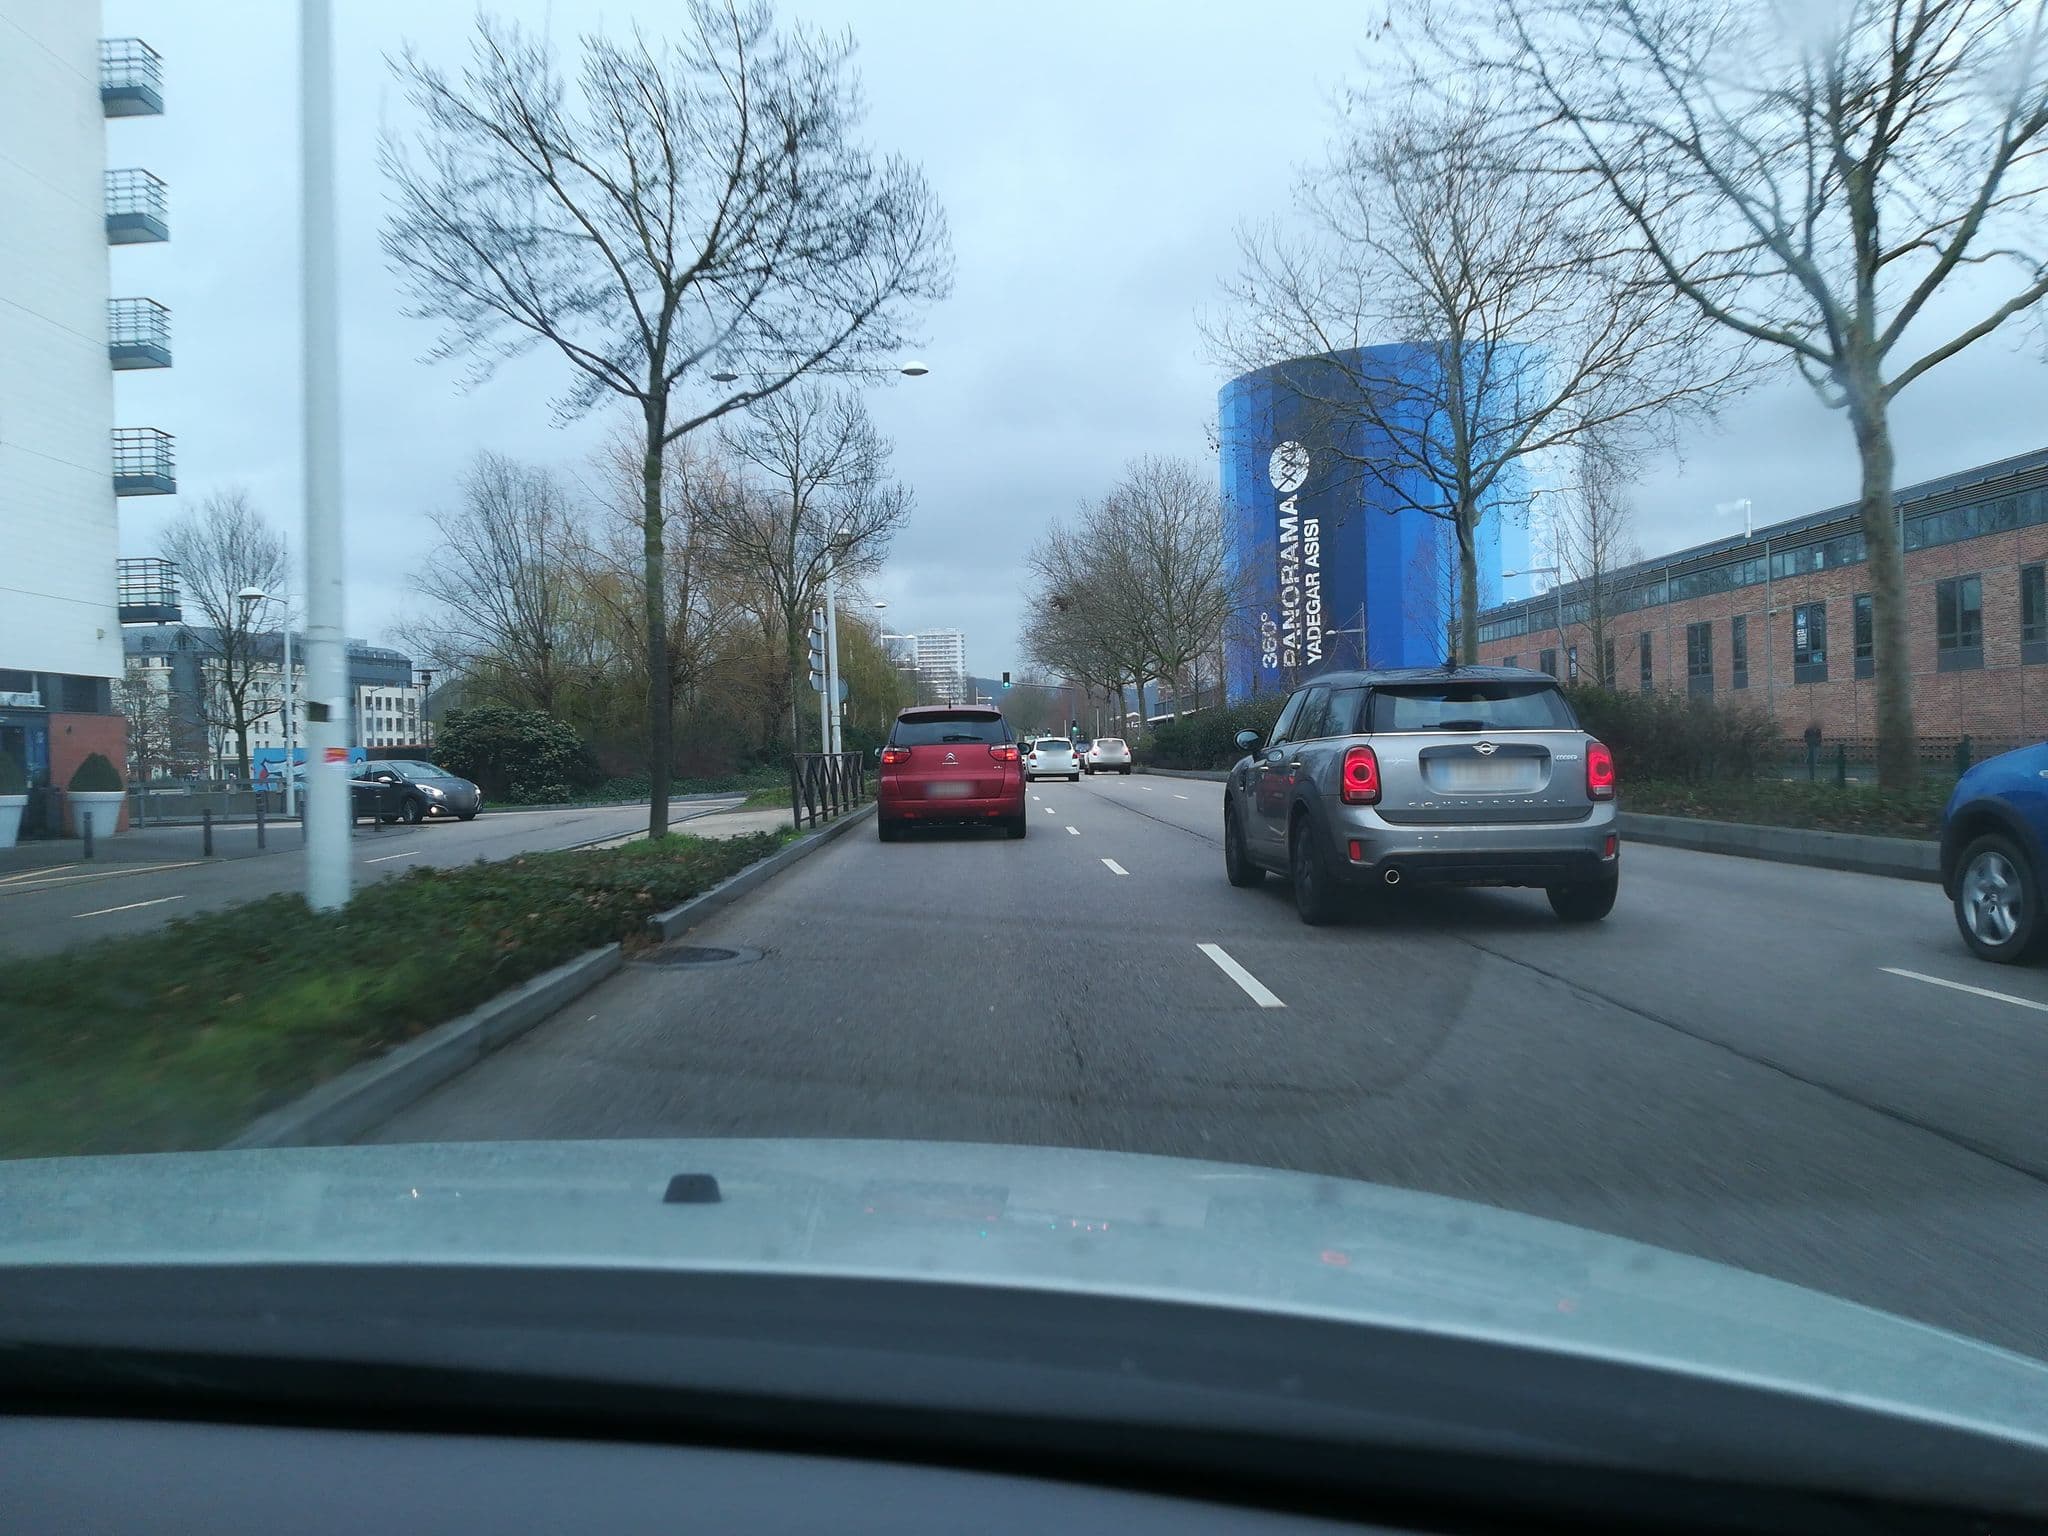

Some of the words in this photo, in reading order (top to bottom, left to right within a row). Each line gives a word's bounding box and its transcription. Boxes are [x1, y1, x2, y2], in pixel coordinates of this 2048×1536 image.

[1279, 494, 1301, 668] PANORAMA
[1304, 518, 1320, 568] ASISI
[1305, 572, 1322, 666] YADEGAR
